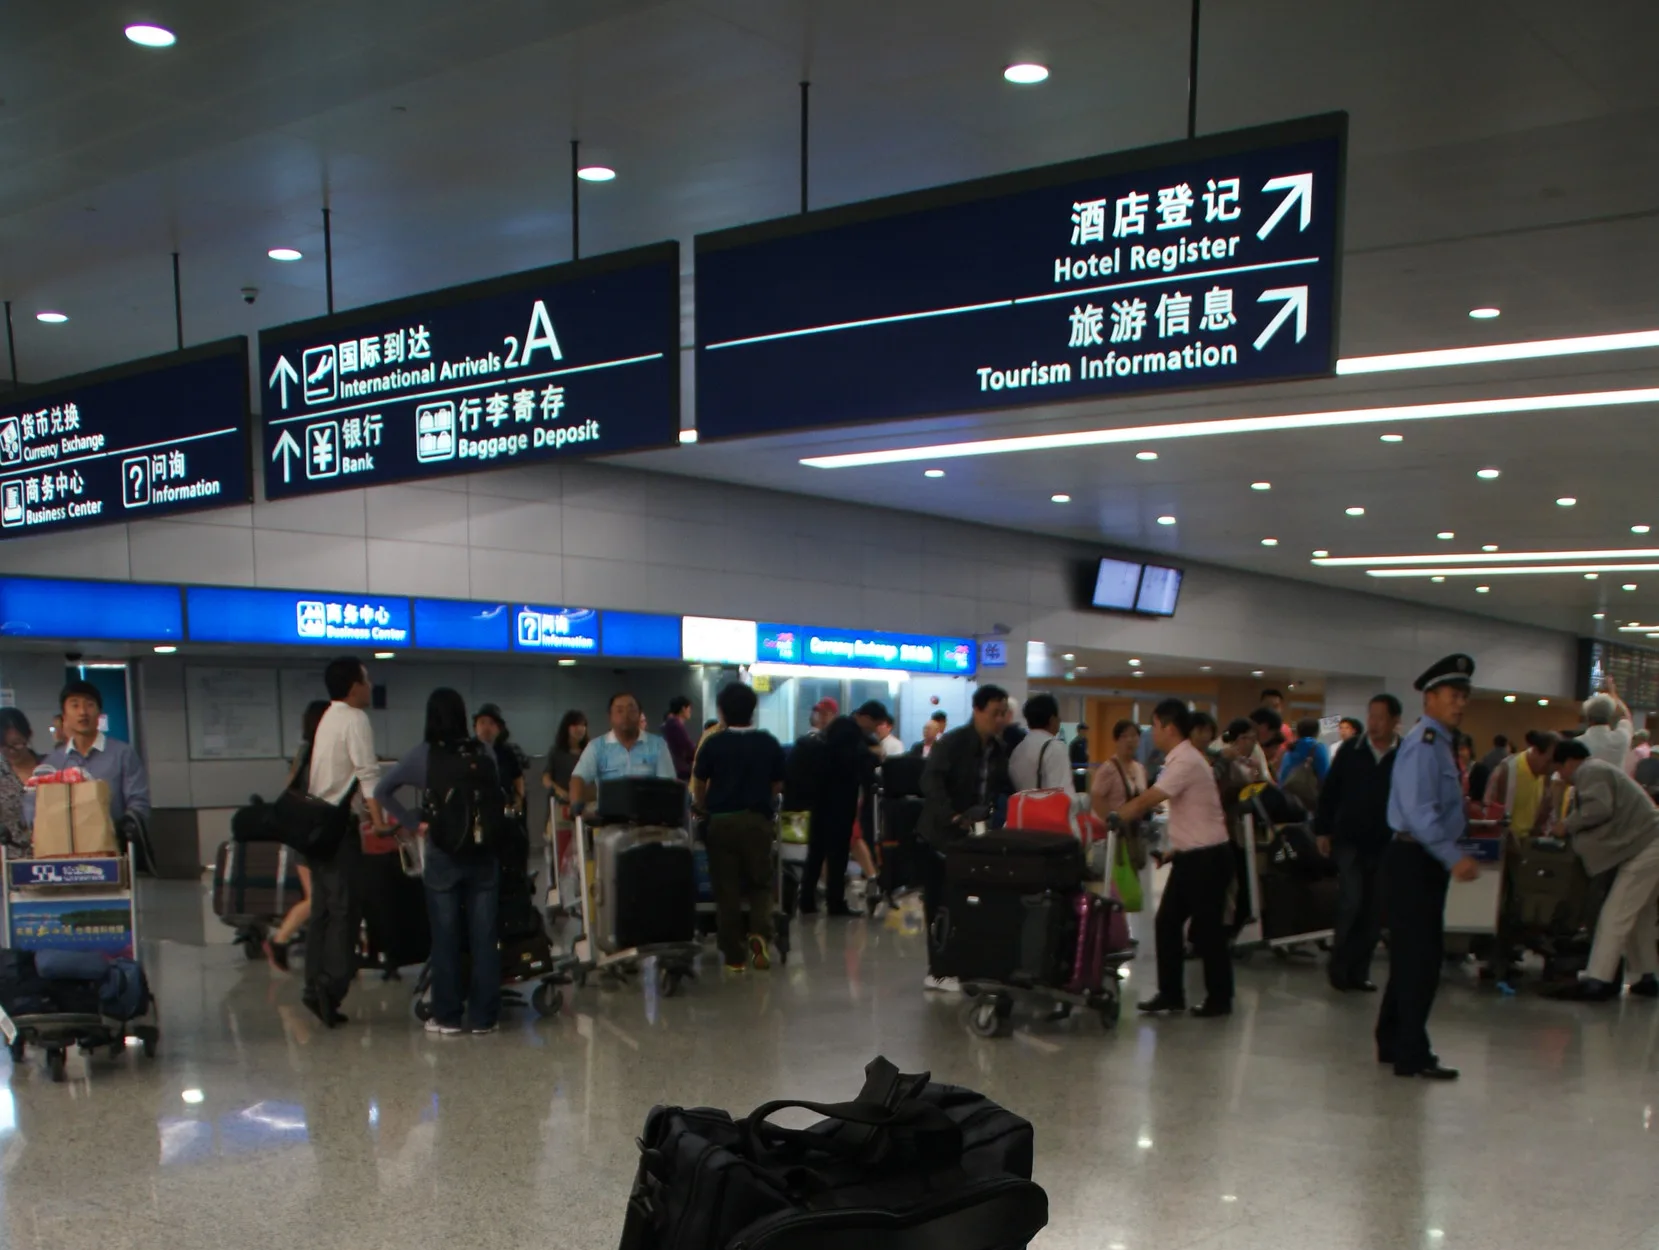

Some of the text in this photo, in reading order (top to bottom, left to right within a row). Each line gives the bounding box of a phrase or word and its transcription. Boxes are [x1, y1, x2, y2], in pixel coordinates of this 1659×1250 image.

[1070, 178, 1242, 246] 酒店登记
[1053, 235, 1241, 283] Hotel Register
[1068, 286, 1238, 348] 旅游信息
[338, 324, 432, 376] 国际到达
[976, 342, 1238, 392] Tourism Information
[340, 366, 436, 398] International
[439, 352, 501, 381] Arrivals
[20, 402, 80, 441] 货币兑换
[458, 384, 566, 432] 行李寄存
[23, 433, 105, 461] Currency Exchange
[341, 413, 384, 449] 银行
[458, 420, 600, 461] Baggage Deposit
[151, 449, 186, 482] 问询
[341, 454, 375, 475] Bank
[26, 469, 85, 504] 商务中心
[152, 479, 221, 504] Information
[26, 500, 102, 525] Business Center
